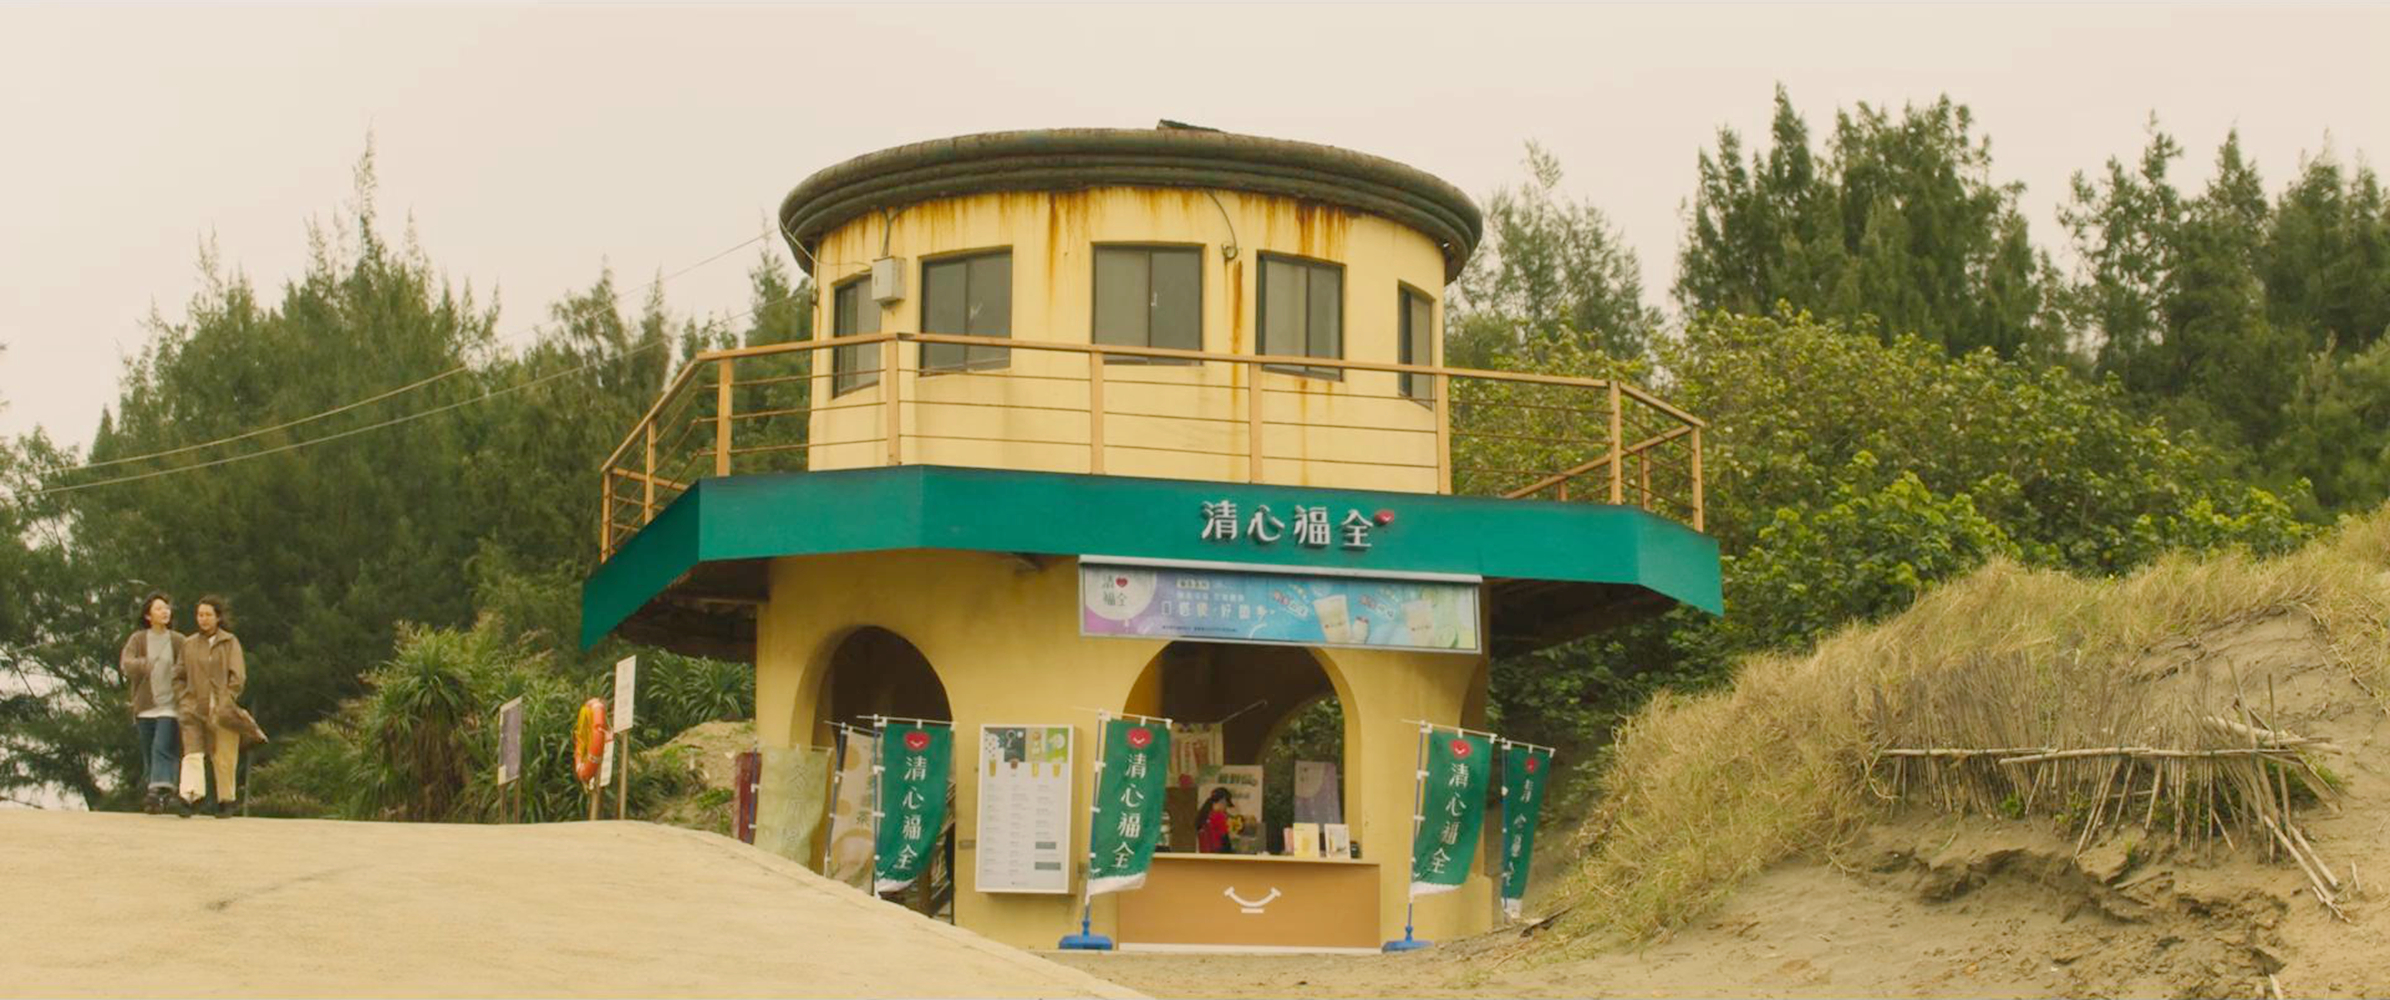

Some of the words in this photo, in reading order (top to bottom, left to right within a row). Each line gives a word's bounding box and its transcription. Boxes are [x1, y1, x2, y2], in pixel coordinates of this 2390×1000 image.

[1202, 500, 1374, 548] 清心福全
[892, 755, 927, 870] 清心福全
[1111, 753, 1147, 868] 清心福全
[1427, 763, 1470, 874] 清心福全
